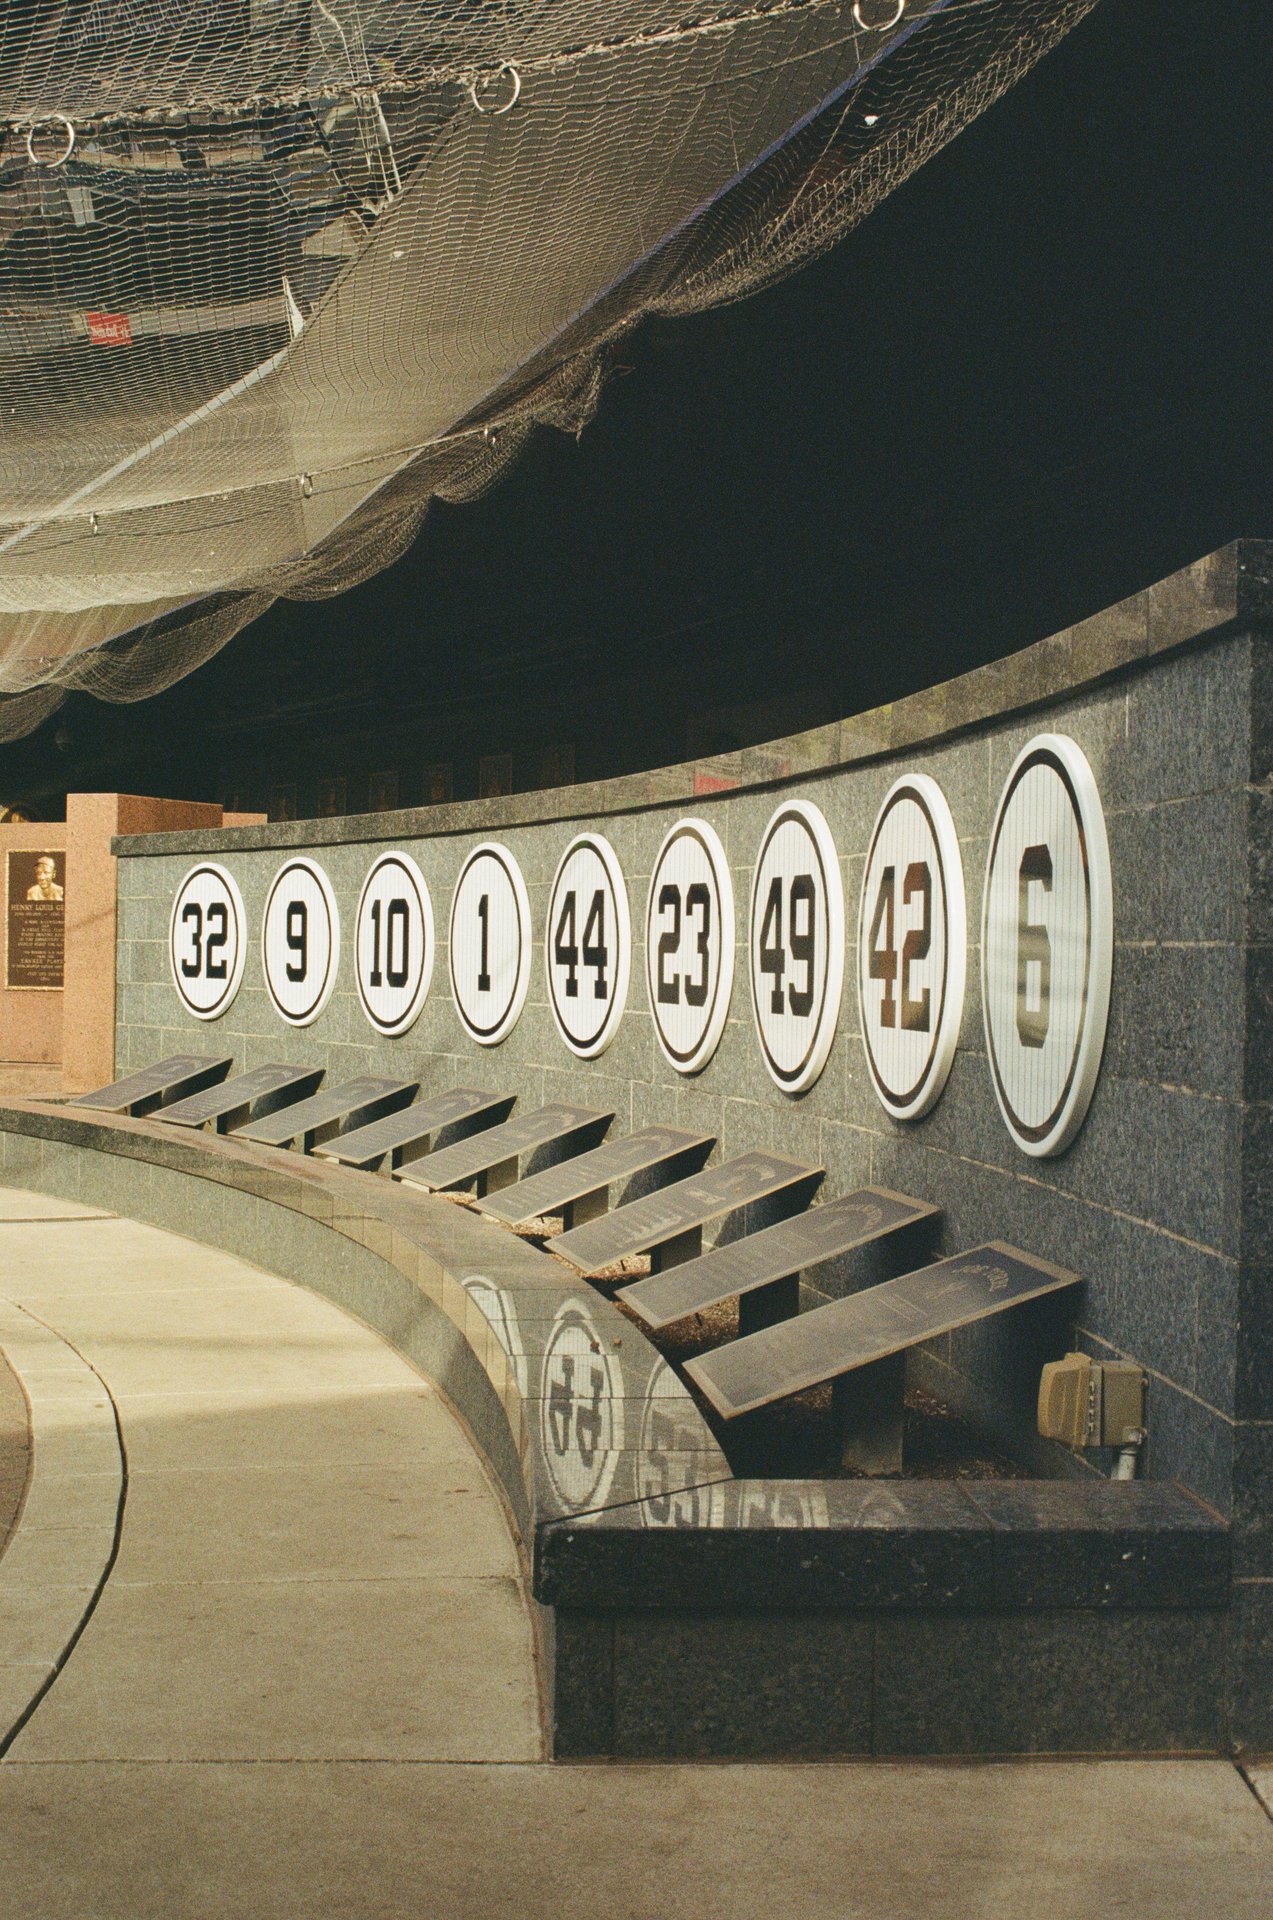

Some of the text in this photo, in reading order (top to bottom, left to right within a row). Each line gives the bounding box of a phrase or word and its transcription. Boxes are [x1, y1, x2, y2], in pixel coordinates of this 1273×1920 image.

[181, 902, 228, 979] 32
[286, 901, 308, 983] 9
[370, 898, 409, 988] 10
[478, 894, 491, 992] 1
[555, 889, 608, 1000] 44
[658, 883, 710, 1007] 23
[759, 874, 816, 1018] 49
[869, 861, 932, 1033] 42
[1016, 843, 1053, 1049] 6
